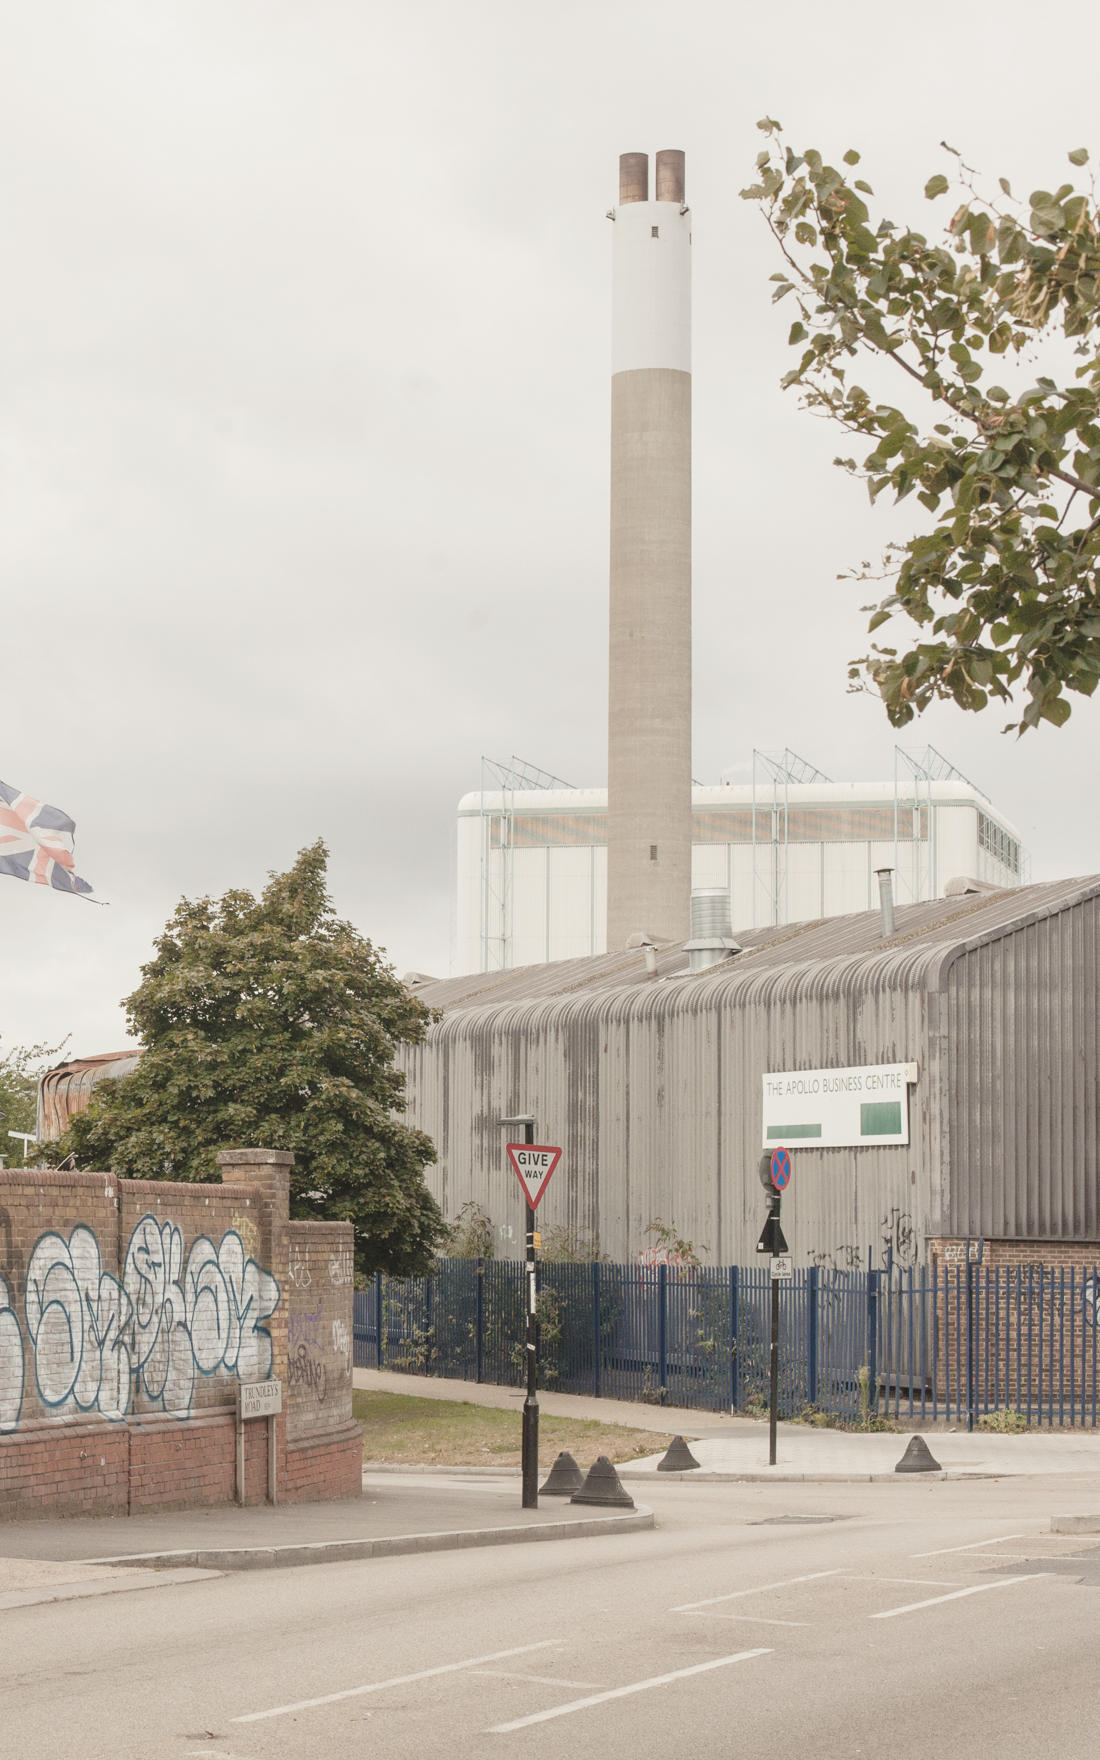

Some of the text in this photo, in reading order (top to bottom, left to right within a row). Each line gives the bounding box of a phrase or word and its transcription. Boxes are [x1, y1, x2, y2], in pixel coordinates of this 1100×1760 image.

[767, 1073, 902, 1096] THE APOLLO BUSINESS CENTRE
[517, 1151, 549, 1167] GIVE
[524, 1169, 544, 1180] WAY
[244, 1399, 261, 1413] ROAD
